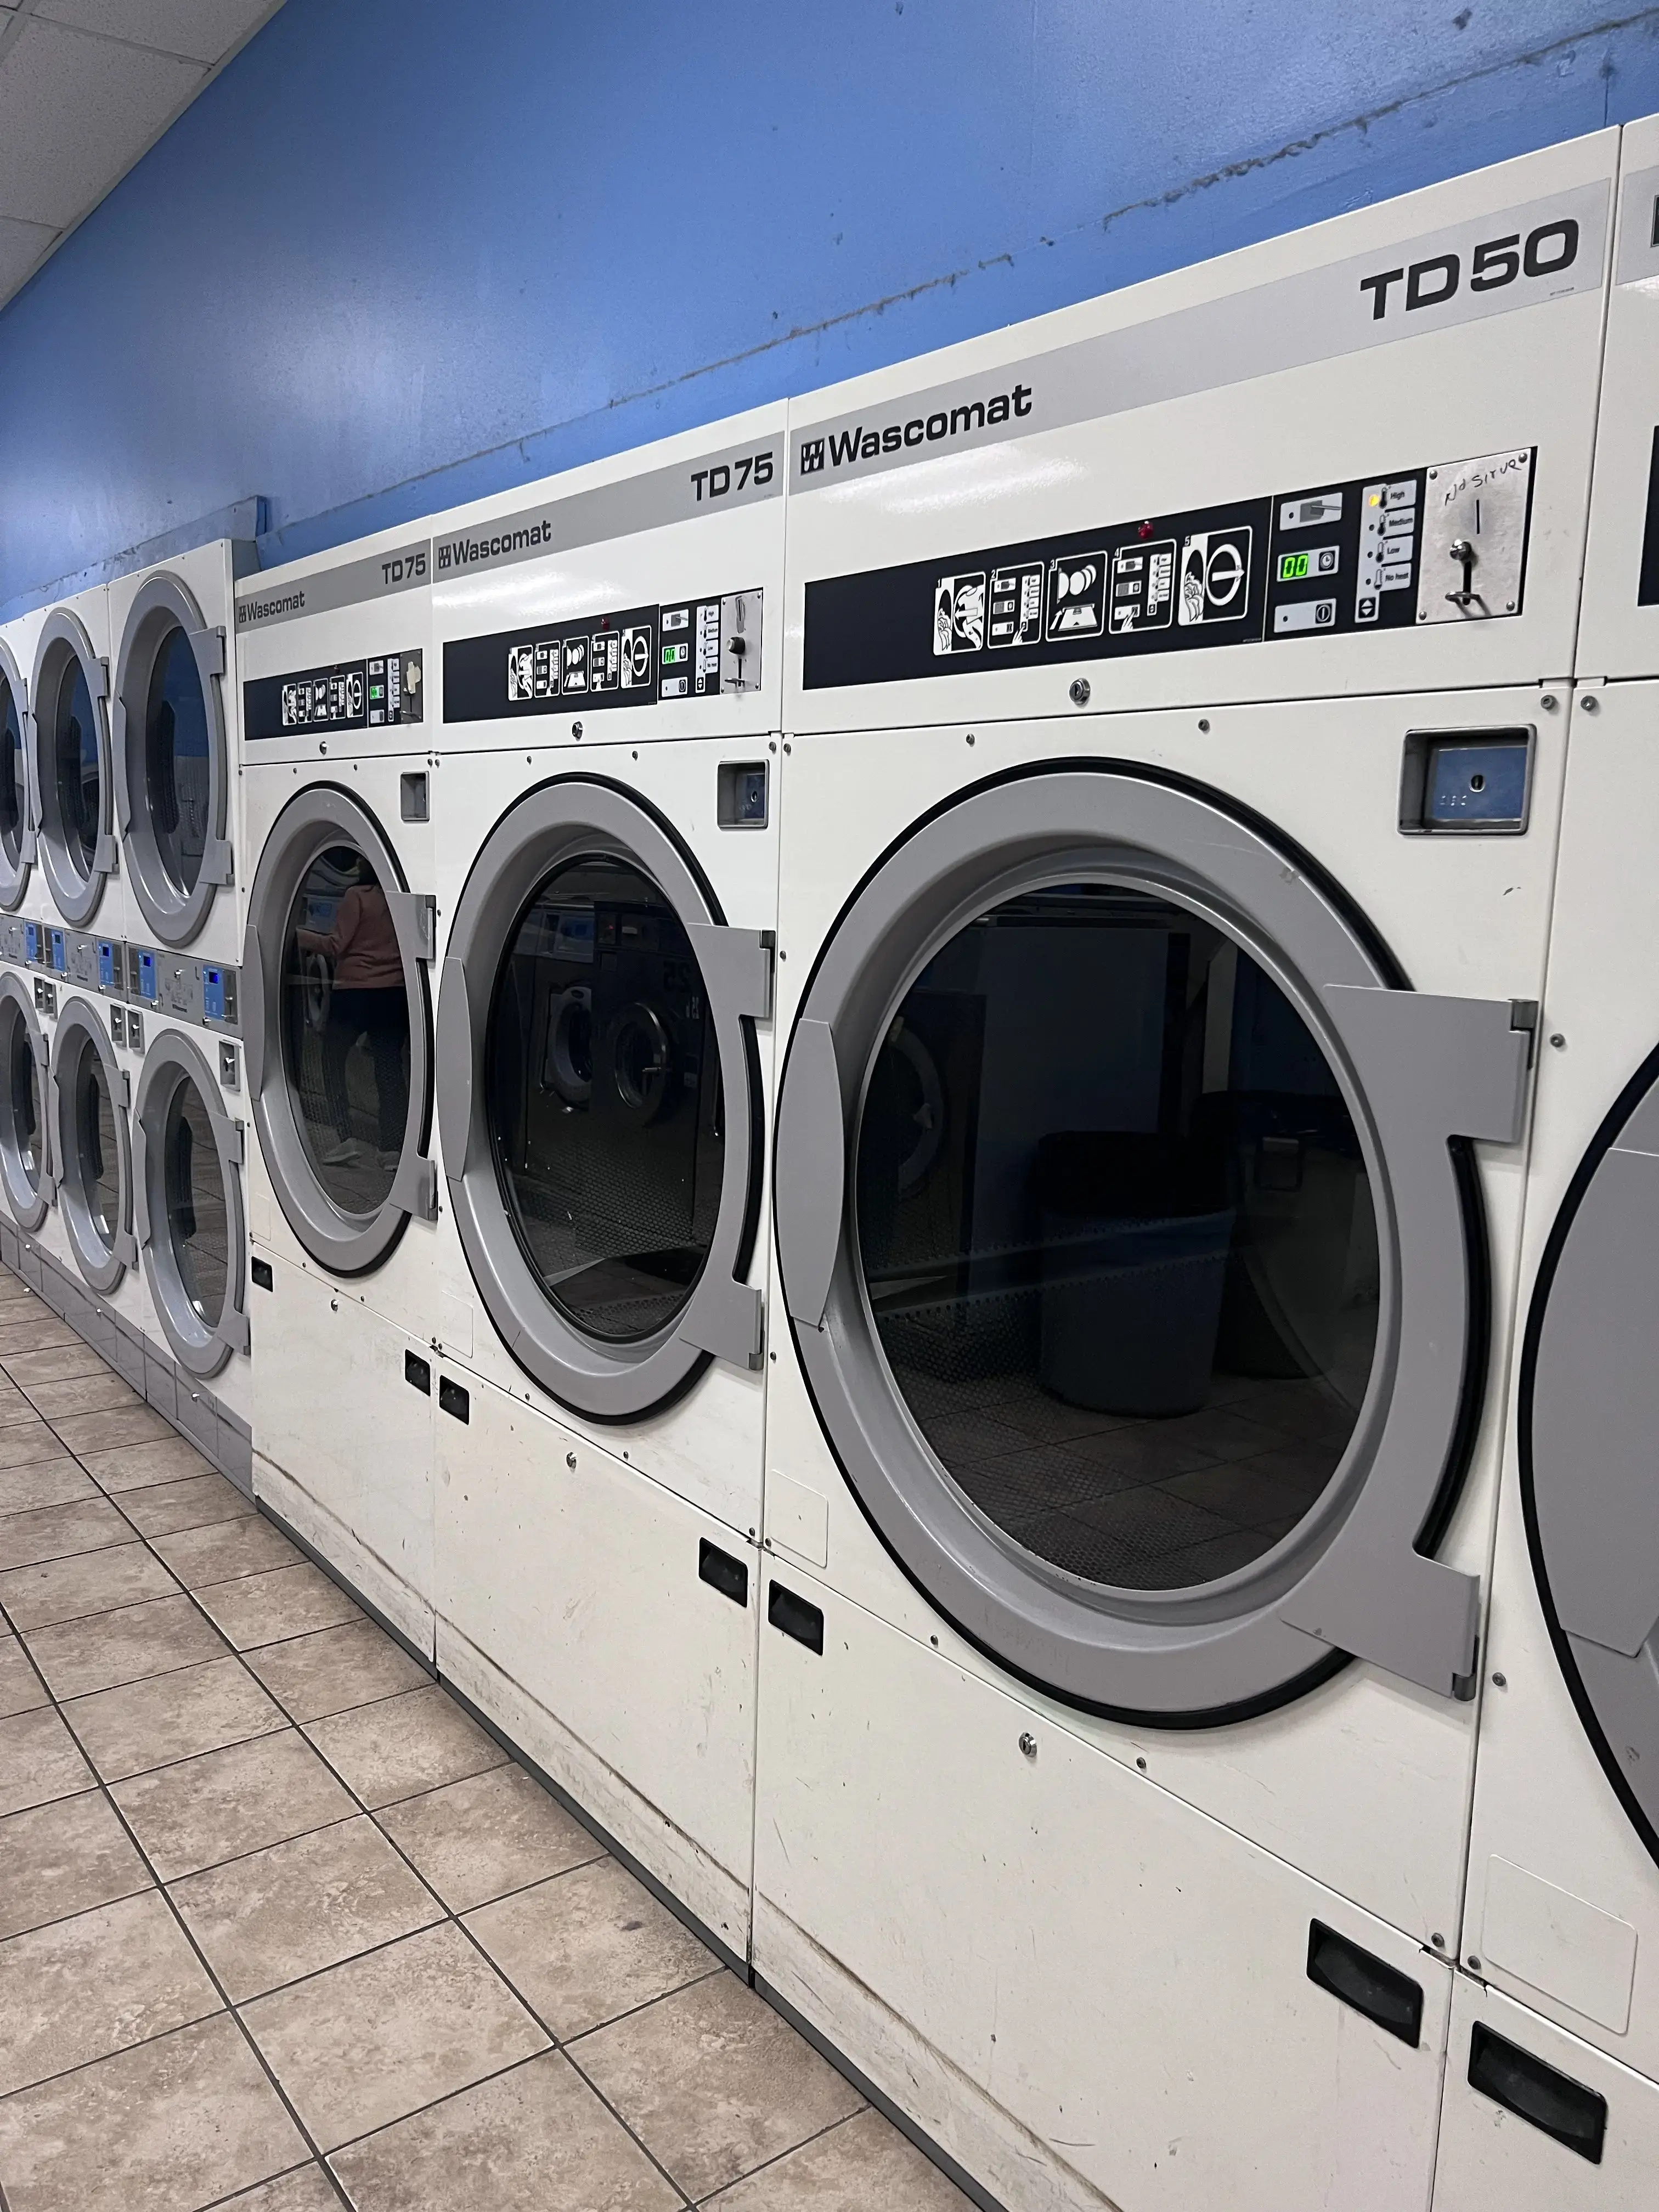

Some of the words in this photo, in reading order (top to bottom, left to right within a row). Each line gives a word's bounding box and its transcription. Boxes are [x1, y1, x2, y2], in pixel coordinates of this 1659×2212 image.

[829, 384, 1032, 467] Wascomat
[1390, 491, 1405, 500] High
[1389, 518, 1413, 527] Medium
[453, 521, 551, 566] Wascomat
[1184, 535, 1190, 546] 5
[1115, 548, 1119, 557] 4
[1050, 559, 1055, 569] 3
[1283, 555, 1308, 578] 00
[991, 569, 996, 579] 2
[247, 591, 305, 621] Wascomat
